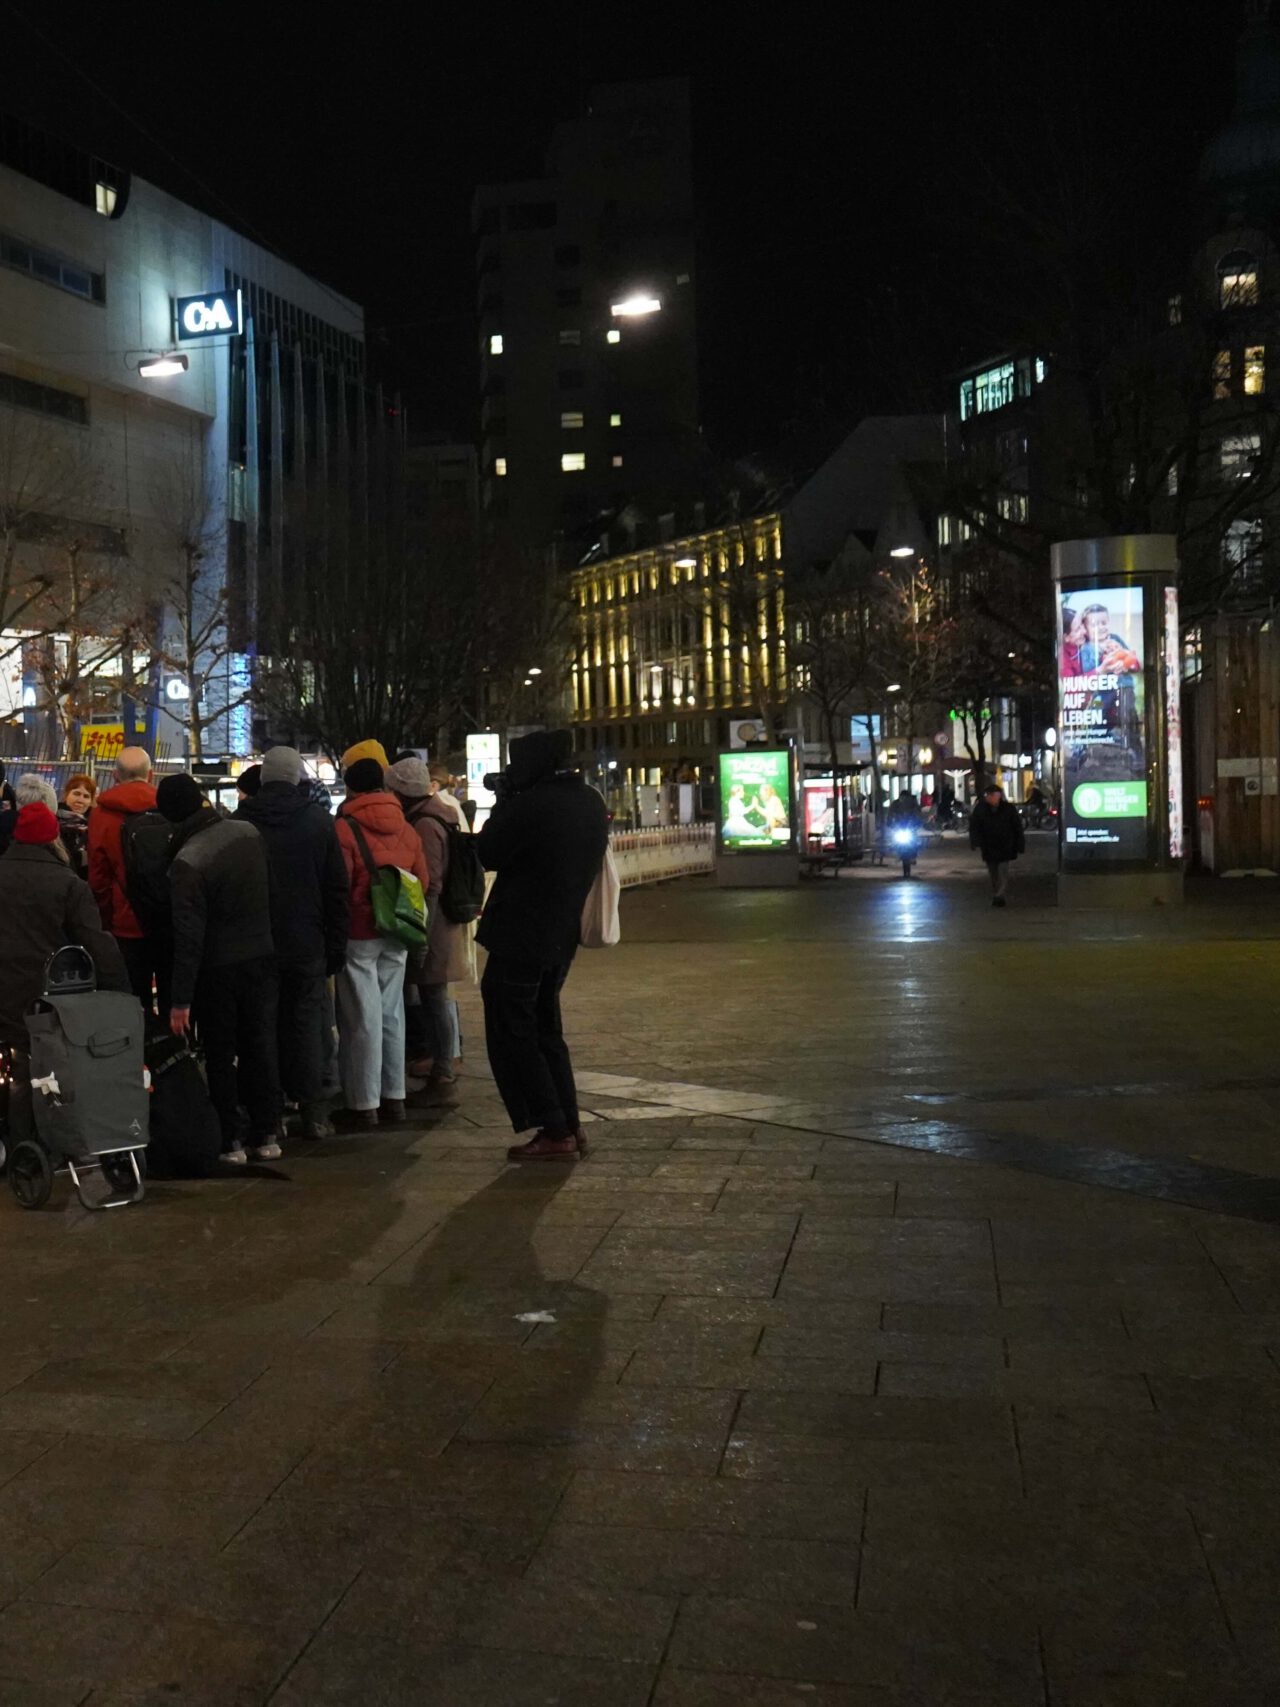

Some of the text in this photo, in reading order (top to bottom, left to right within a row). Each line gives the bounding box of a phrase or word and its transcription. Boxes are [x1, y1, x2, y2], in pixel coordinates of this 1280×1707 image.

[1063, 674, 1119, 692] HUNGER
[1063, 692, 1086, 709] AUF
[1063, 709, 1108, 726] LEBEN.
